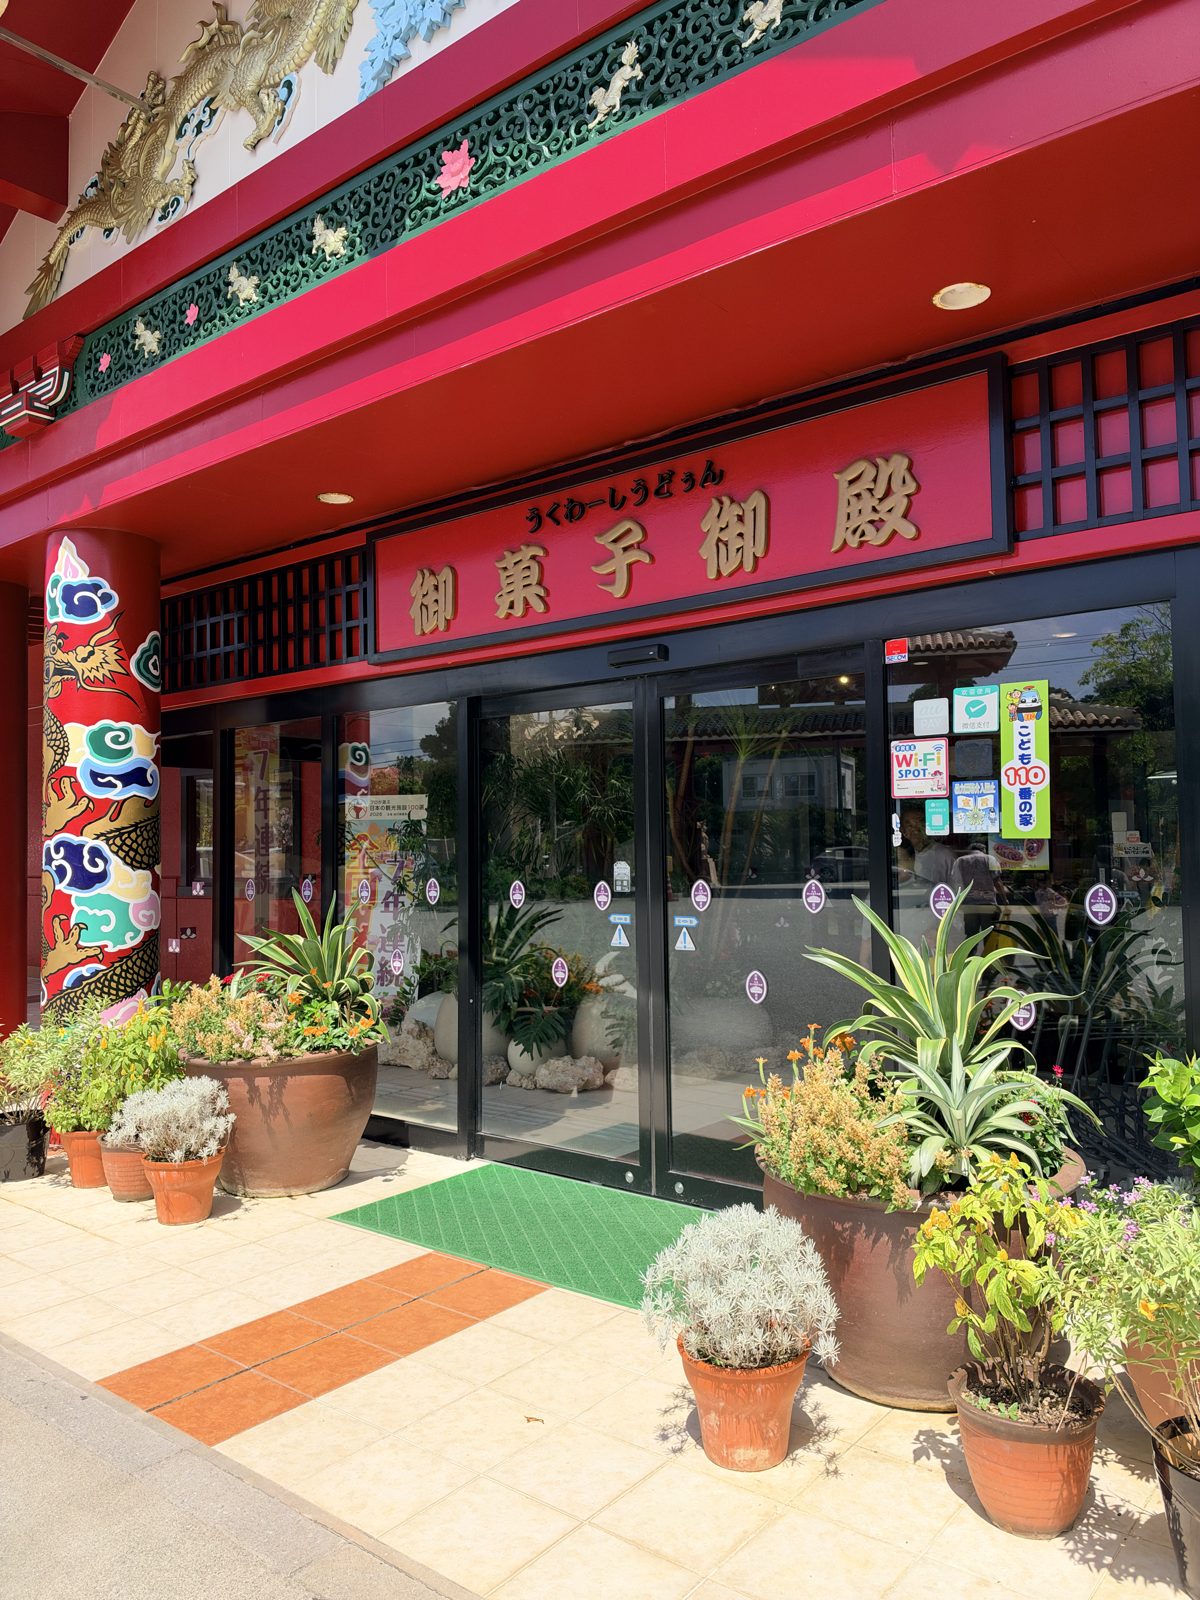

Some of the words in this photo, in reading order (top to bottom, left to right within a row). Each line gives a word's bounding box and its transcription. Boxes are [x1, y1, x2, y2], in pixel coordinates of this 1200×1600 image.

[409, 452, 920, 637] 御菓子御殿
[895, 752, 941, 768] Wi-Fi
[898, 768, 928, 779] SPOT
